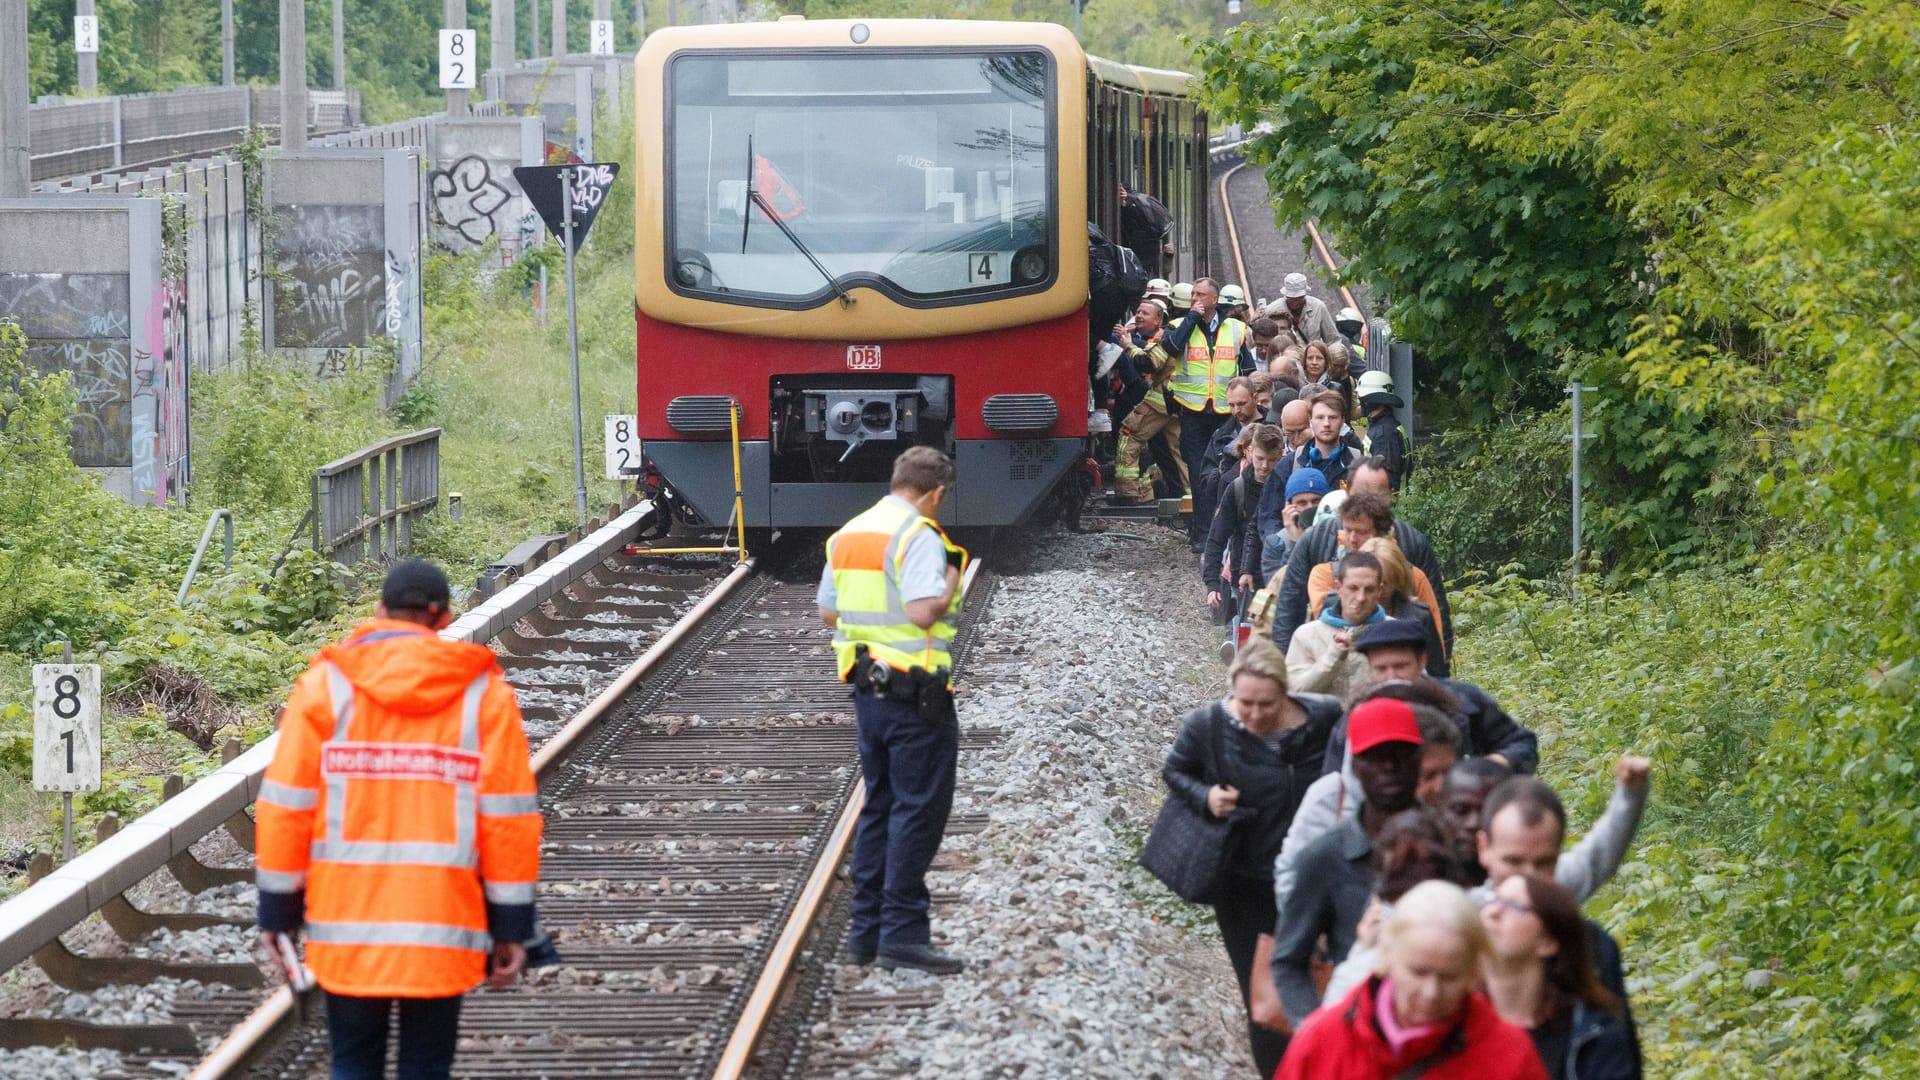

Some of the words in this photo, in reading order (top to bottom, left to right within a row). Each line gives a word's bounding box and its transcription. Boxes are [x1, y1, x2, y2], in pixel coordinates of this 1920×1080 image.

[82, 18, 90, 32] 8
[599, 23, 606, 37] 8
[83, 36, 91, 48] 4
[451, 33, 464, 56] 8
[451, 62, 464, 84] 2
[977, 255, 993, 280] 4
[850, 349, 878, 366] DB
[615, 420, 629, 443] 8
[616, 448, 630, 471] 2
[53, 674, 81, 719] 8
[60, 730, 74, 774] 1
